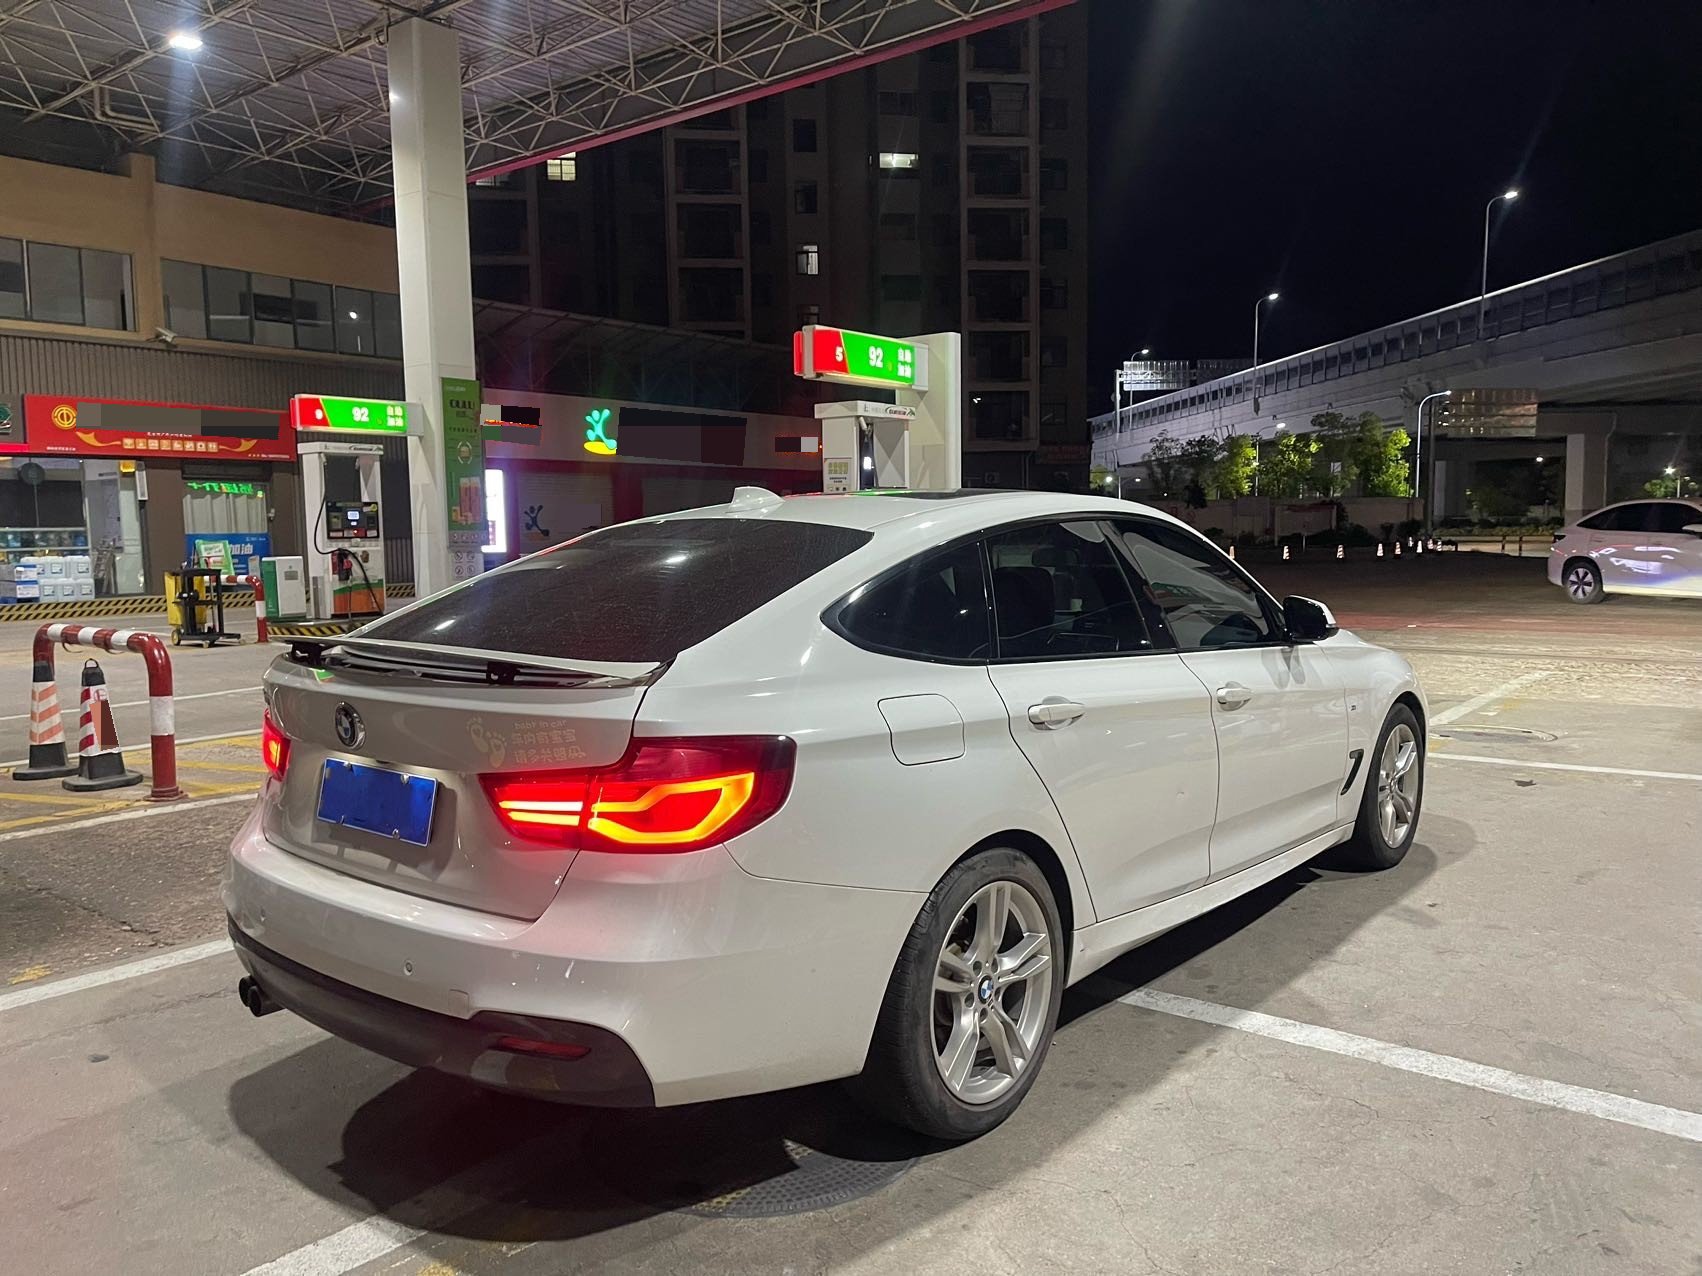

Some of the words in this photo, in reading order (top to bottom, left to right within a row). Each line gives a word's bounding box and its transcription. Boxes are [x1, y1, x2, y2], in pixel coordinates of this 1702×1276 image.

[835, 346, 843, 362] 5
[868, 346, 884, 368] 92
[352, 407, 369, 422] 92
